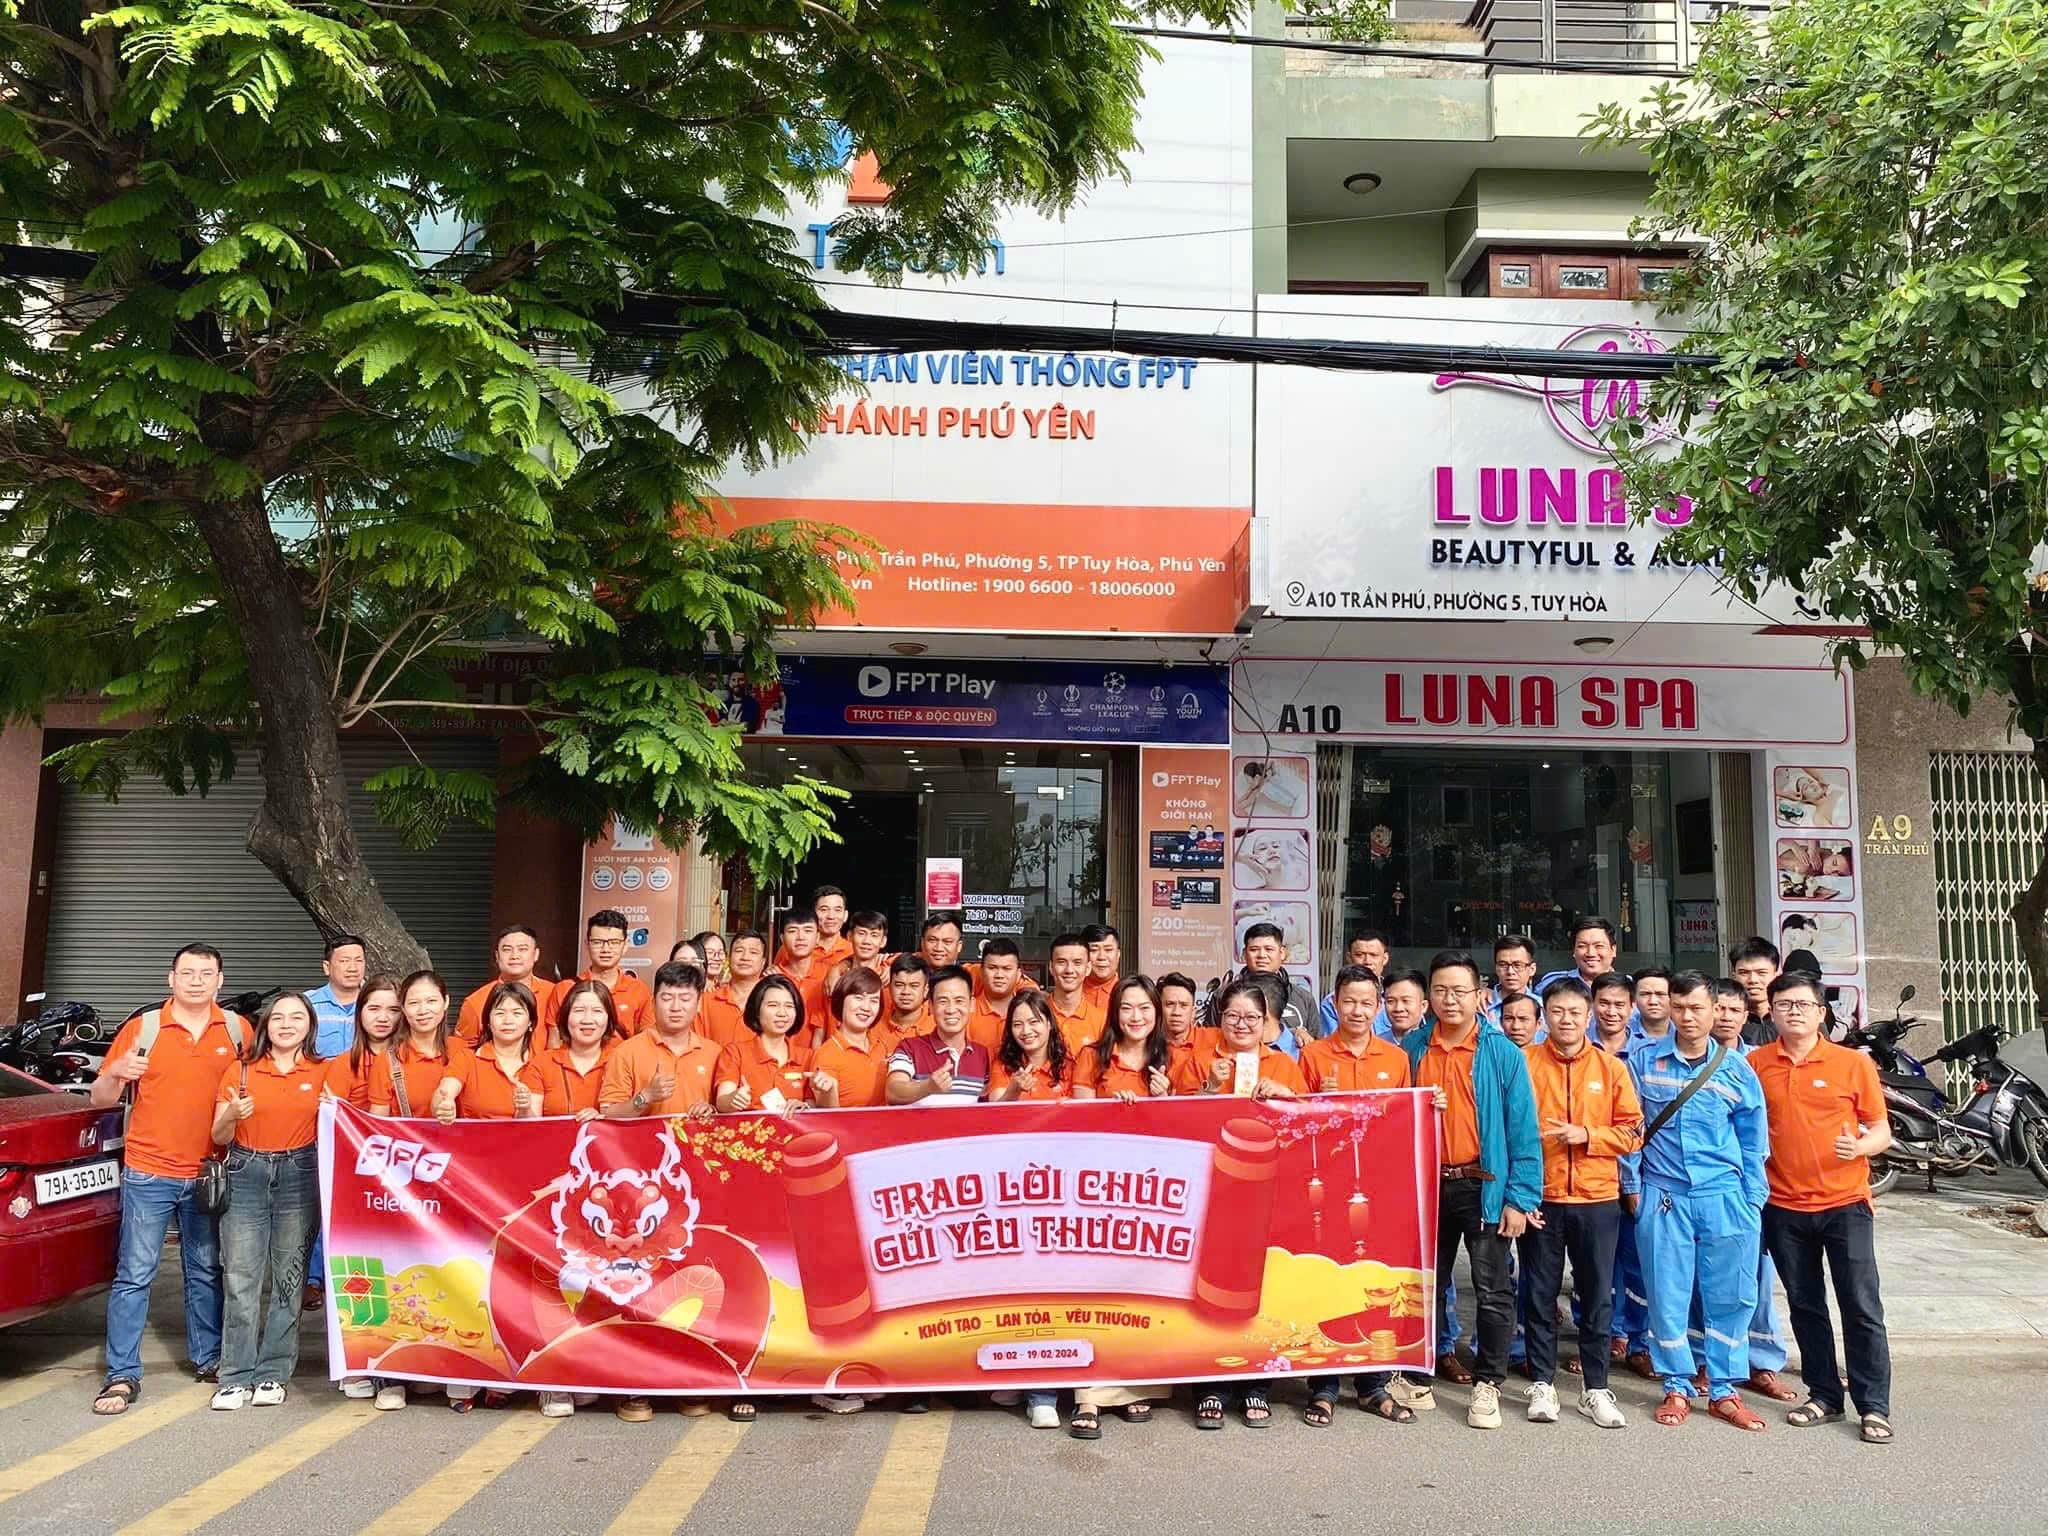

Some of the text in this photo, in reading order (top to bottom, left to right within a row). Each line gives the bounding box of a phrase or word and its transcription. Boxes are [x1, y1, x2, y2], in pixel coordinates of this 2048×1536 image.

[1011, 352, 1131, 388] THÔNG
[1138, 358, 1198, 389] FPT
[791, 397, 1095, 440] HÁNH PHÚ YÊN
[1434, 466, 1628, 527] LUNA
[877, 550, 916, 567] Trần
[922, 551, 960, 570] Phú,
[965, 553, 1033, 572] Phường
[1037, 556, 1053, 571] 5,
[1058, 555, 1078, 569] TP
[1082, 556, 1111, 574] Tuy
[1116, 556, 1155, 573] Hòa,
[1159, 557, 1193, 572] Phú
[1198, 557, 1226, 572] Yên
[1431, 538, 1600, 568] BEAUTYFUL
[1614, 541, 1635, 568] &
[908, 576, 977, 593] Hotline:
[983, 578, 1025, 593] 1900
[1029, 579, 1073, 594] 6600
[1090, 581, 1176, 596] 18006000
[1305, 591, 1337, 608] A10
[1341, 585, 1388, 609] TRẦN
[1433, 590, 1508, 611] PHƯỜNG
[1531, 594, 1565, 612] TUY
[1570, 590, 1607, 612] HÒA
[895, 672, 996, 699] FPT Play
[1089, 703, 1140, 712] CHAMPIONS
[1384, 672, 1699, 731] LUNA SPA
[915, 711, 923, 721] &
[1278, 703, 1342, 734] A10
[1171, 775, 1221, 788] FPT Play
[1166, 798, 1207, 809] KHÔNG
[1866, 815, 1912, 841] A9
[1864, 841, 1929, 856] TRẦN PHÚ
[963, 895, 1025, 905] WORKING TIME
[965, 909, 987, 921] 7h30
[994, 910, 1021, 921] 18h00
[1152, 917, 1183, 930] 200
[873, 1161, 1187, 1219] TRAO LỜI CHÚC
[873, 1213, 1192, 1267] GỬI YÊU THƯƠNG
[956, 1316, 982, 1335] TẠO
[996, 1312, 1021, 1328] LAN
[1094, 1310, 1150, 1329] THƯƠNG
